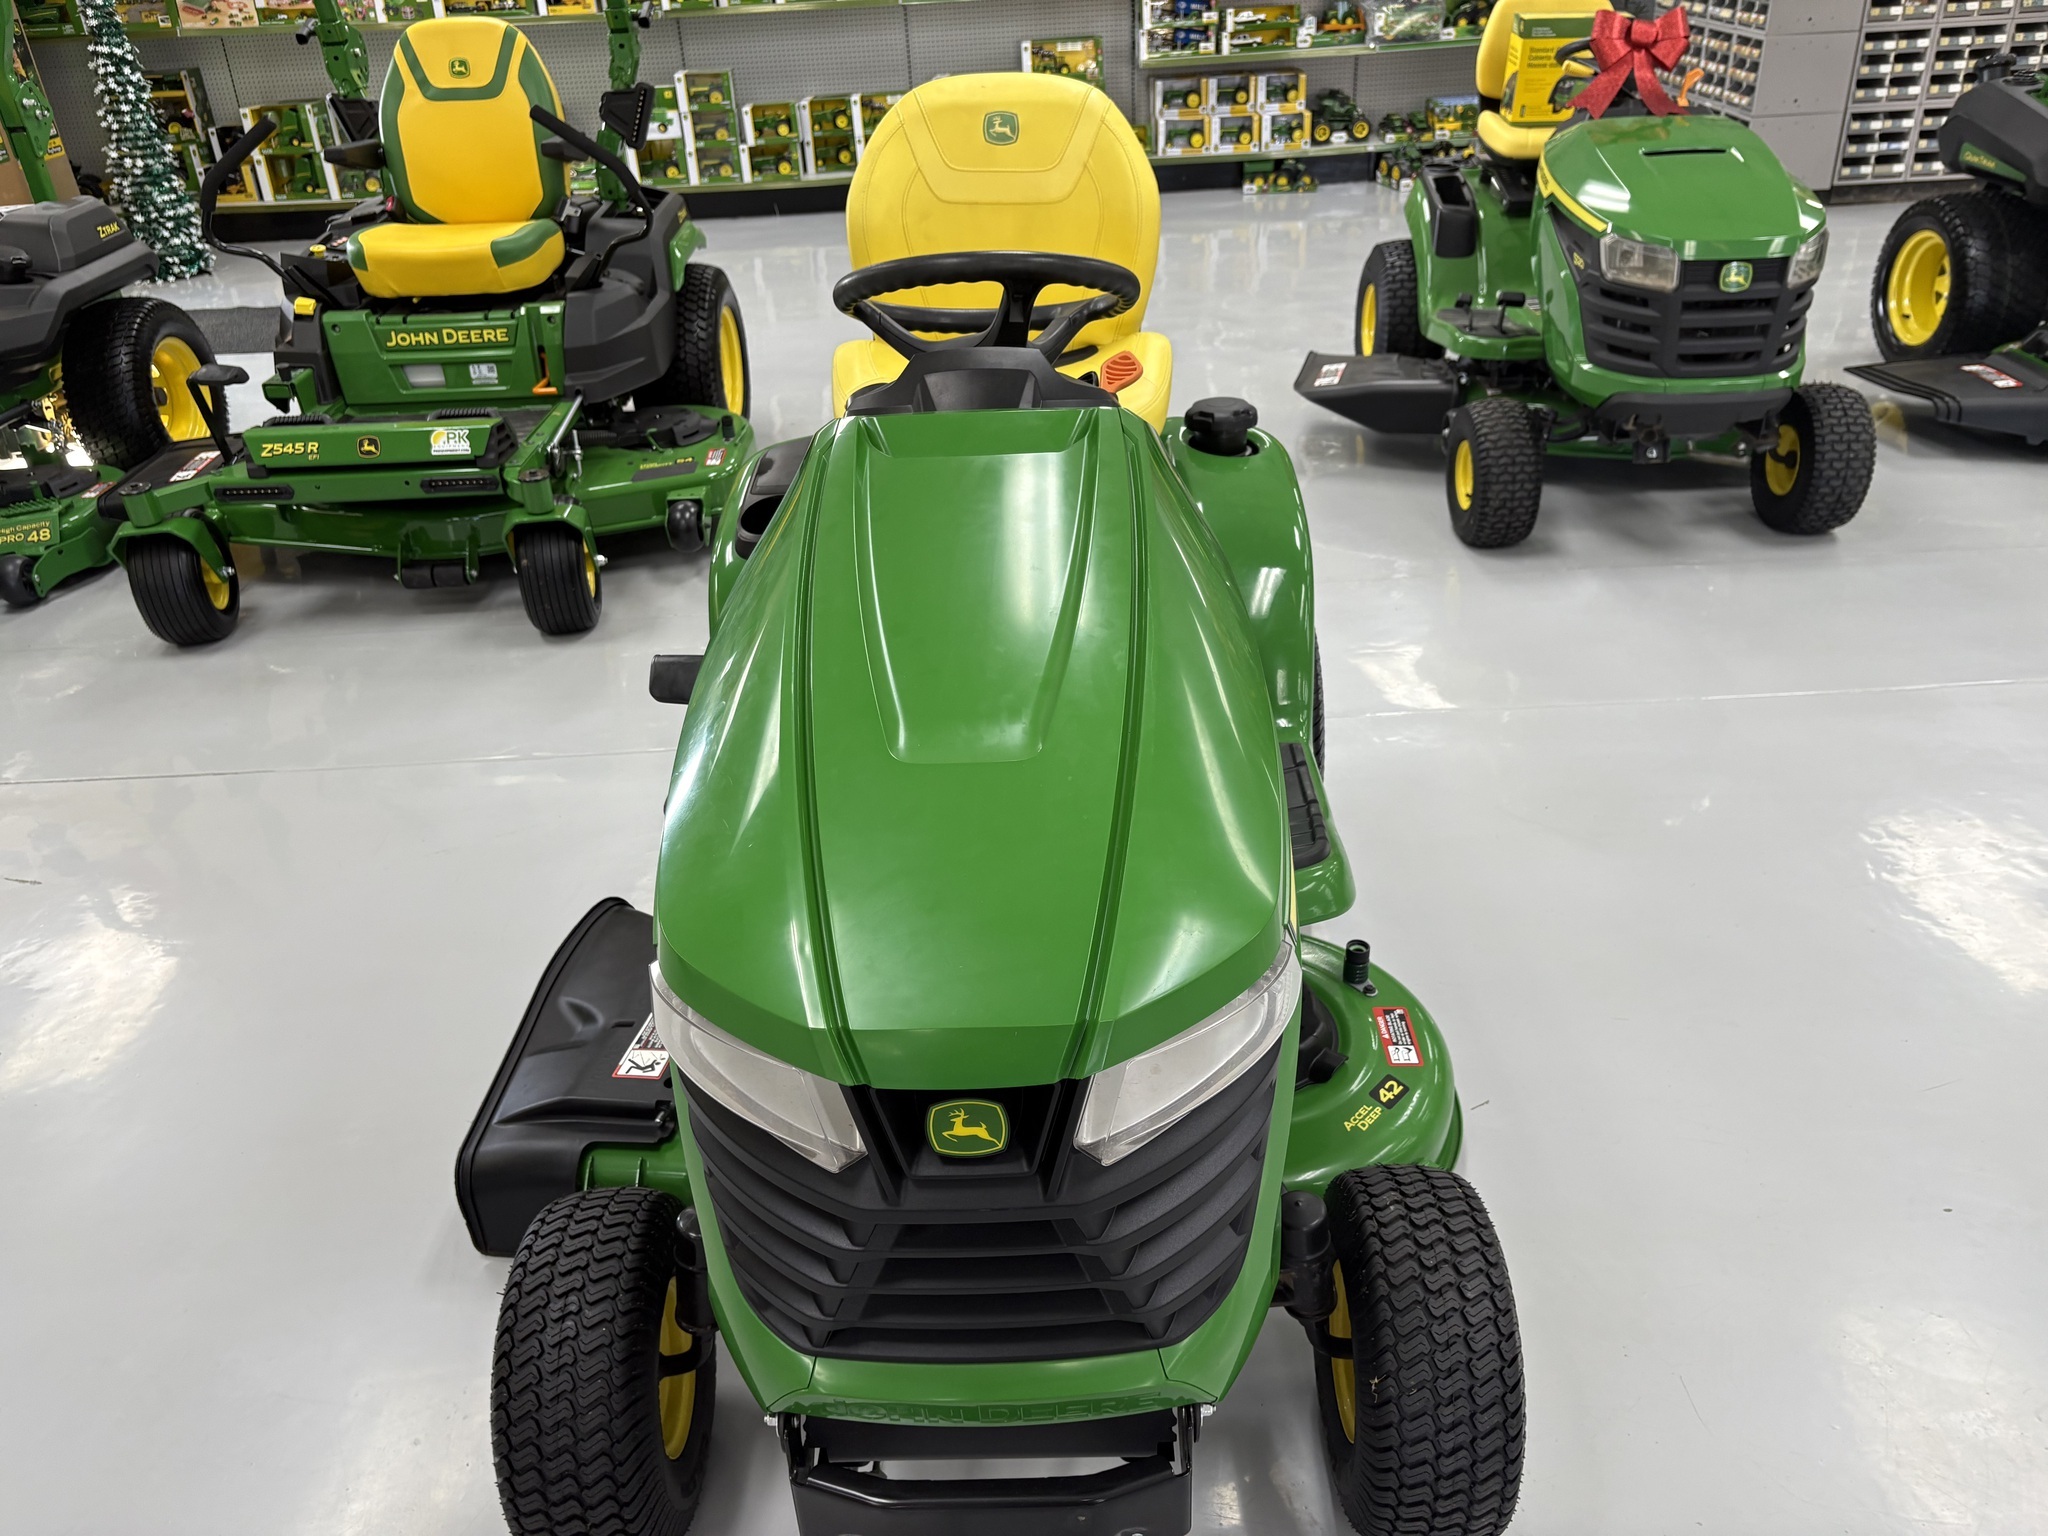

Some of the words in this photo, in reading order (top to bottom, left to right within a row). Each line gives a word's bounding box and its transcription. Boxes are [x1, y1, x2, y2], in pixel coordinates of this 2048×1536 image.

[386, 330, 439, 347] JOHN
[442, 328, 509, 344] DEERE
[0, 532, 25, 544] PRO
[27, 528, 51, 543] 48
[16, 520, 50, 531] Capacity
[1379, 1080, 1404, 1103] 42
[1343, 1104, 1373, 1132] ACCEL
[1357, 1106, 1382, 1131] DEEP
